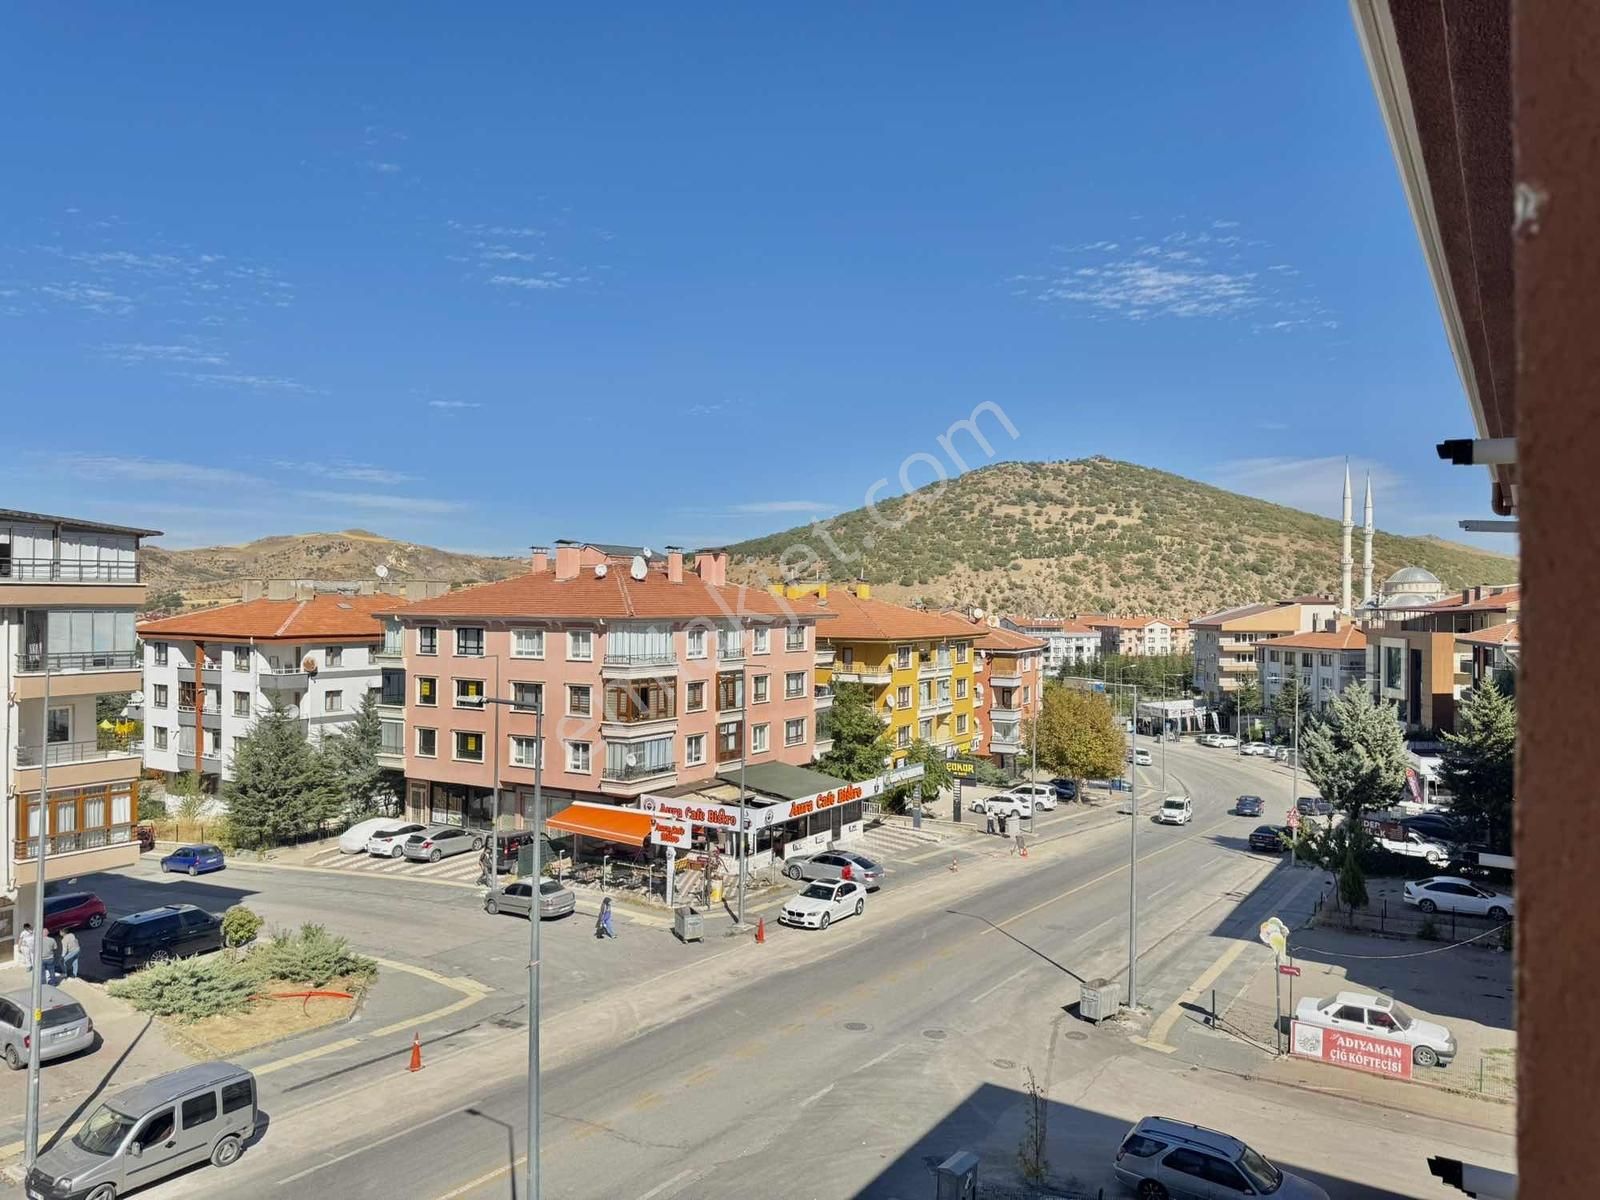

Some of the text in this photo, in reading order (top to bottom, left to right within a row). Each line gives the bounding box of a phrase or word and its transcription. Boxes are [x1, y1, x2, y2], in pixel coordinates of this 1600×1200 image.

[837, 783, 863, 804] Bistro
[707, 808, 737, 827] Bistro
[1336, 1036, 1403, 1058] ADIYAMAN
[1330, 1048, 1403, 1073] ÇİĞ KÖFTECİSİ
